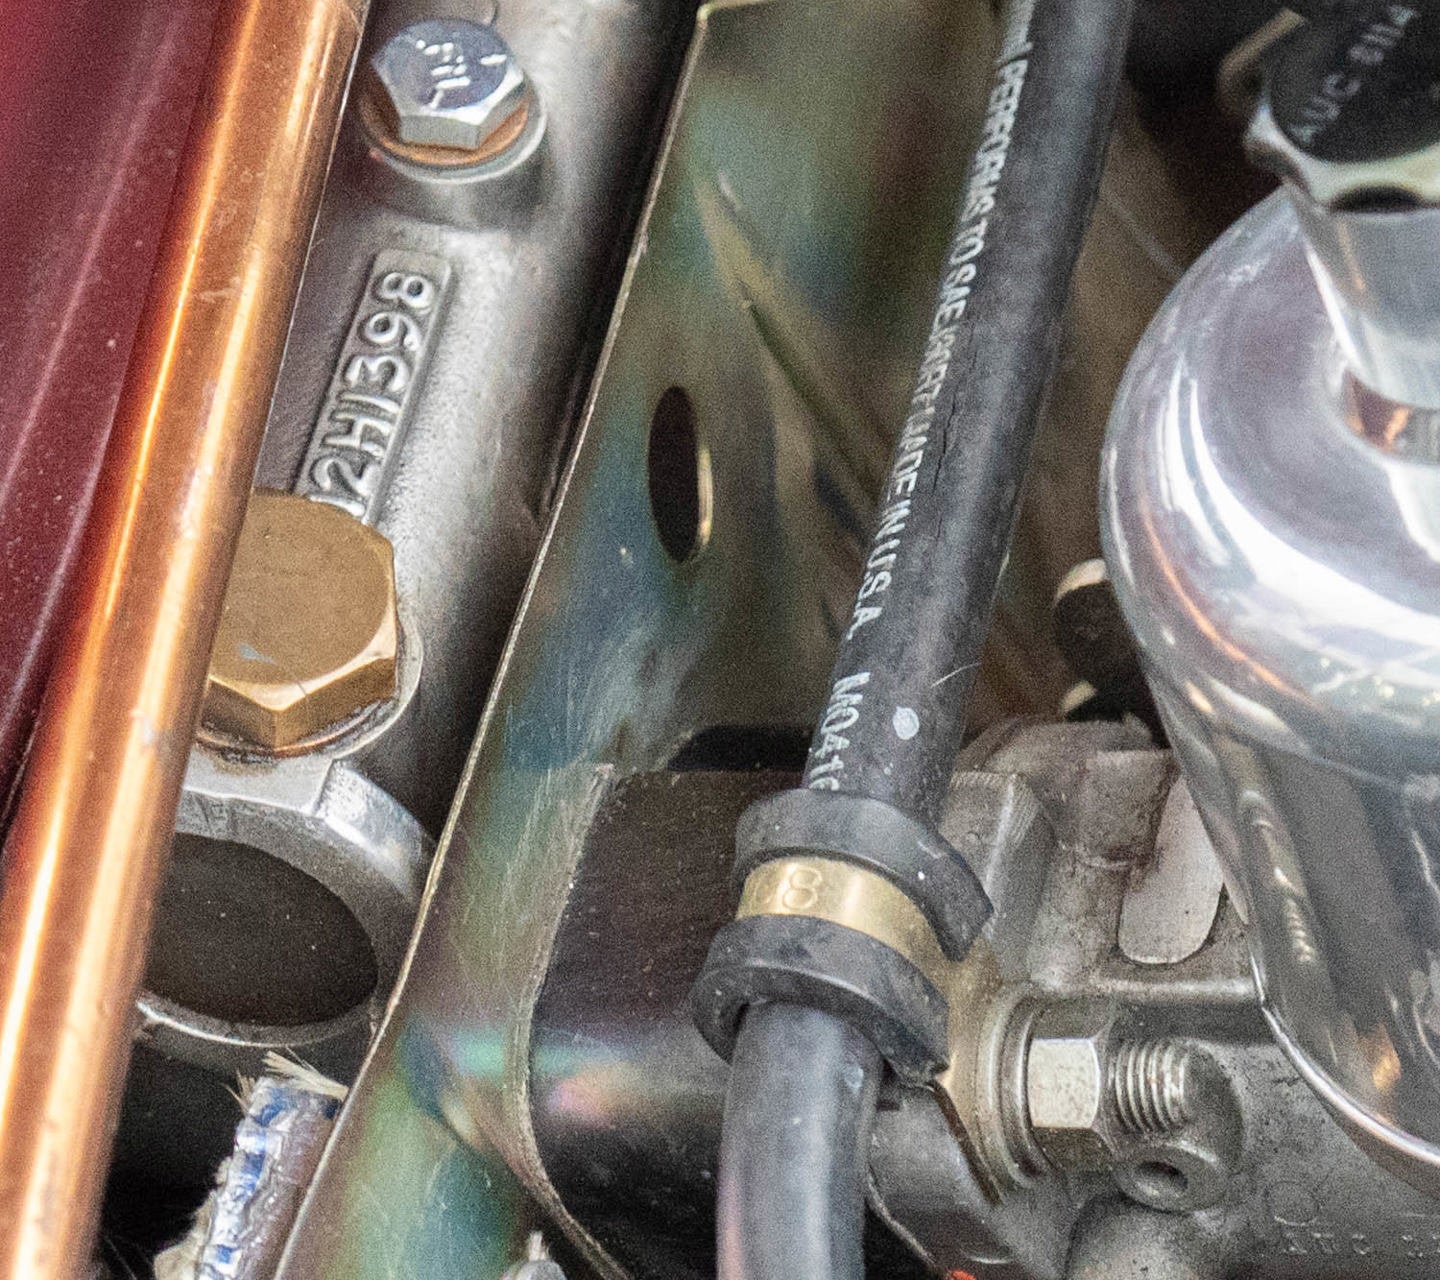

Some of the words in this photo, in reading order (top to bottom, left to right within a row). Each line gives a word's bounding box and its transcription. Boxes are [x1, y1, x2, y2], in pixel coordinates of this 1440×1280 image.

[948, 216, 989, 265] TO
[931, 262, 977, 333] SAE
[888, 406, 934, 502] MADE
[876, 499, 913, 541] IN
